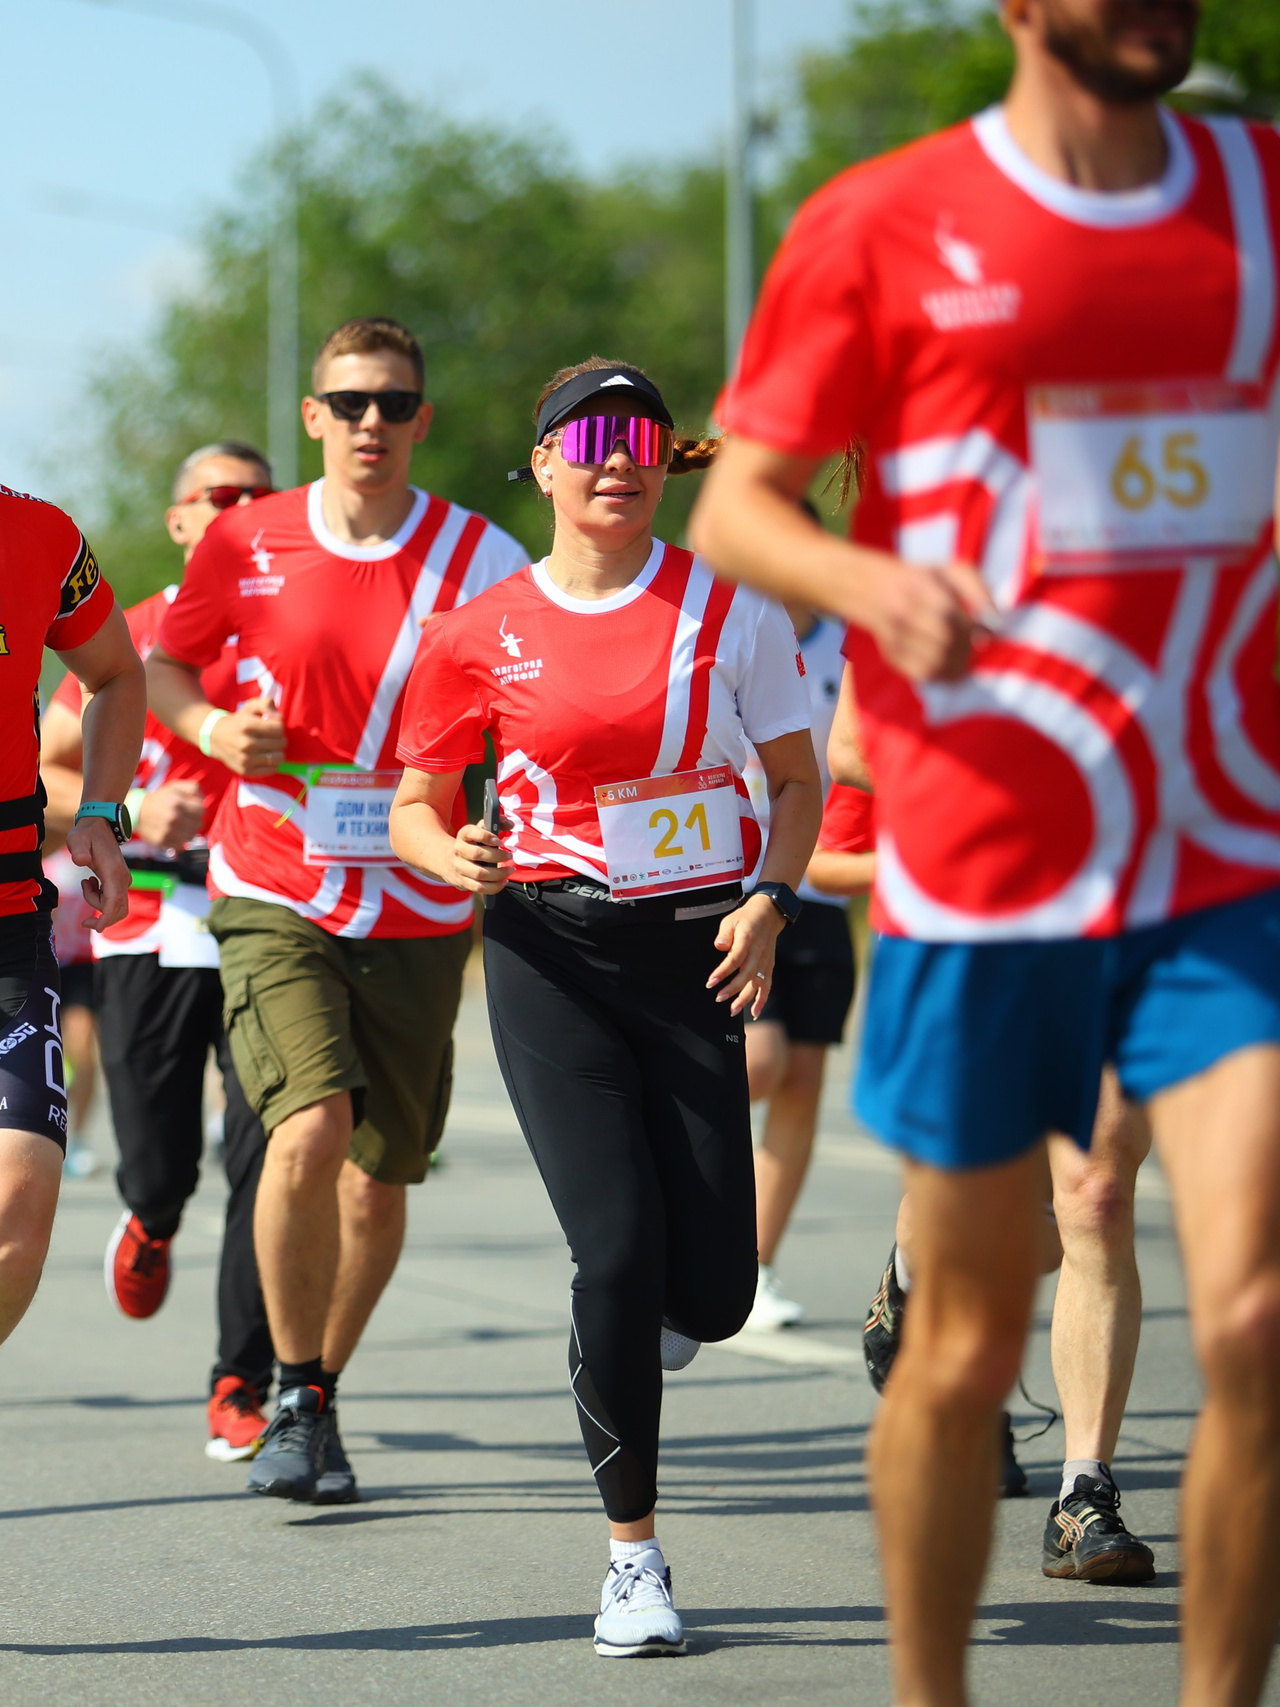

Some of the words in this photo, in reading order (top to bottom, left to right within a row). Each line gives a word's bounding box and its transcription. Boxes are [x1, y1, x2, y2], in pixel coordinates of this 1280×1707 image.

[1110, 432, 1209, 512] 65
[648, 802, 711, 859] 21
[562, 880, 636, 907] DEM
